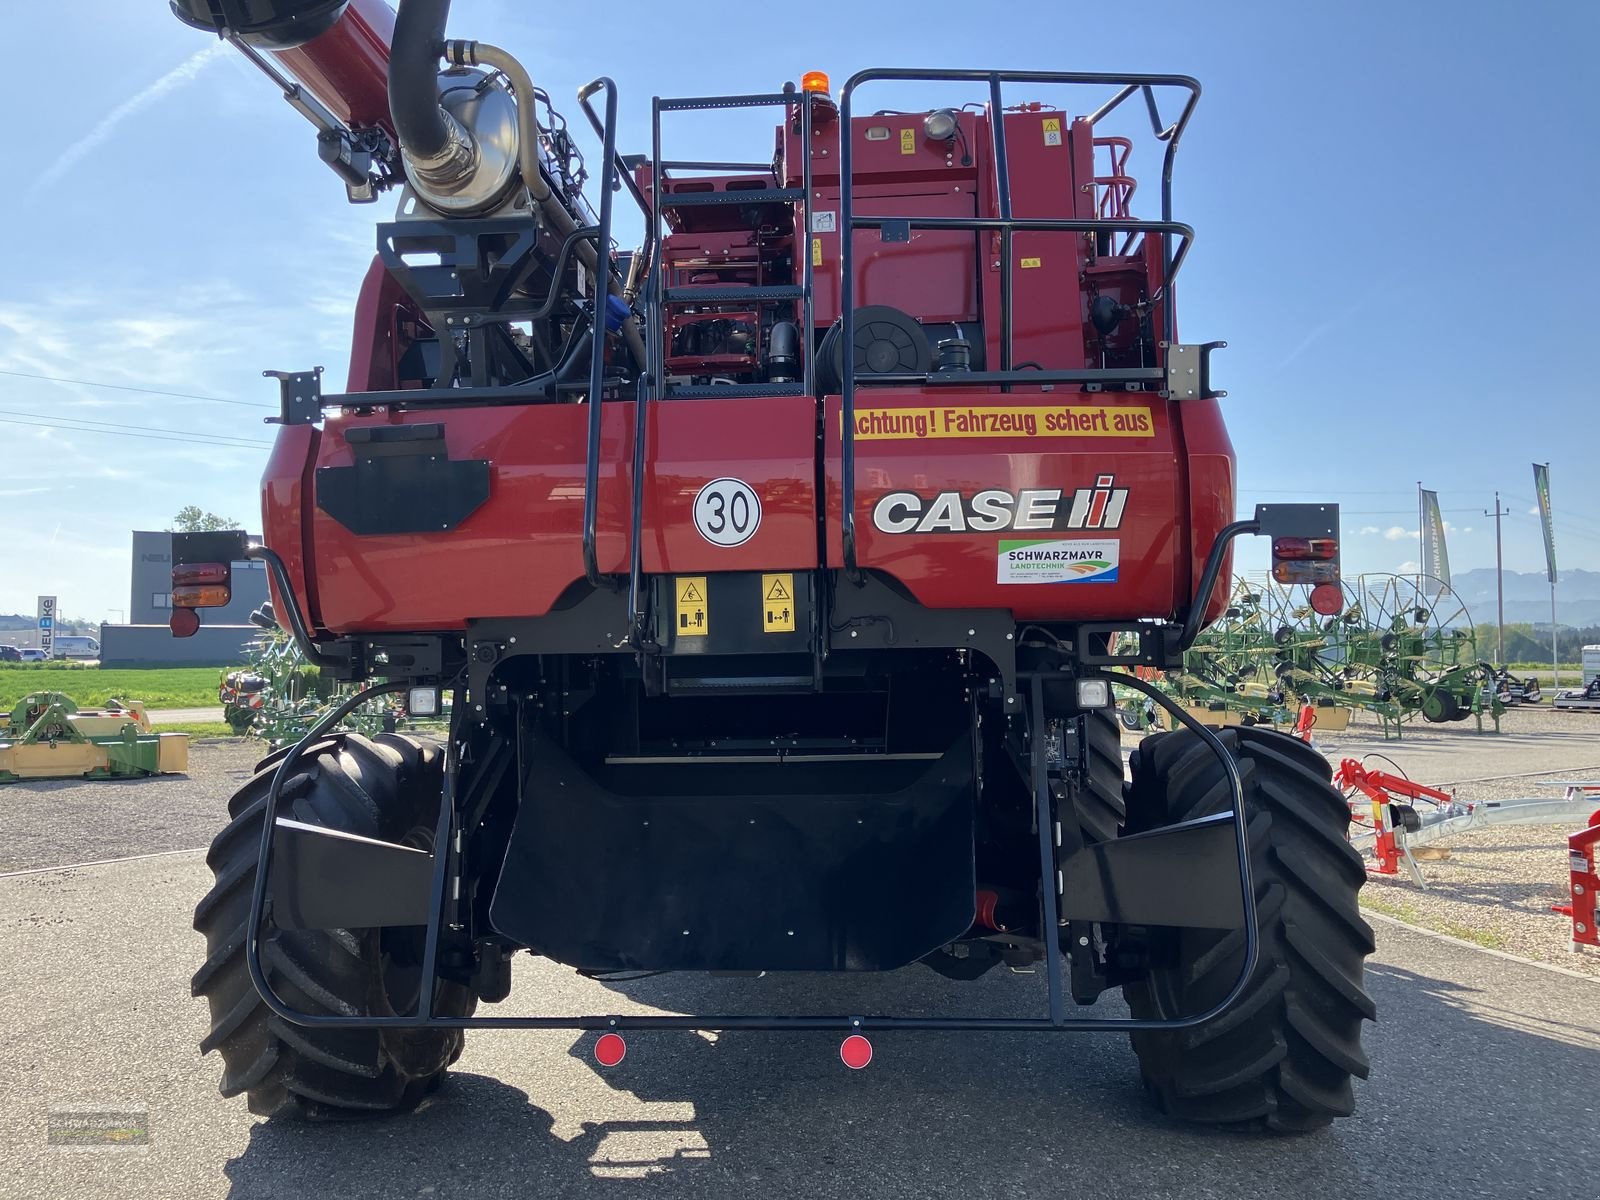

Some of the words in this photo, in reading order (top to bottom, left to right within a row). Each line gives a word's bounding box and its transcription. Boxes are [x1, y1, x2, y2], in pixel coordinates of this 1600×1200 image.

[943, 409, 1038, 436] Fahrzeug
[1045, 408, 1109, 432] schert
[1113, 413, 1150, 432] aus
[706, 490, 750, 535] 30
[872, 488, 1063, 535] CASE
[1008, 550, 1103, 561] SCHWARZMAYR
[1010, 562, 1065, 570] LANDTECHNIK
